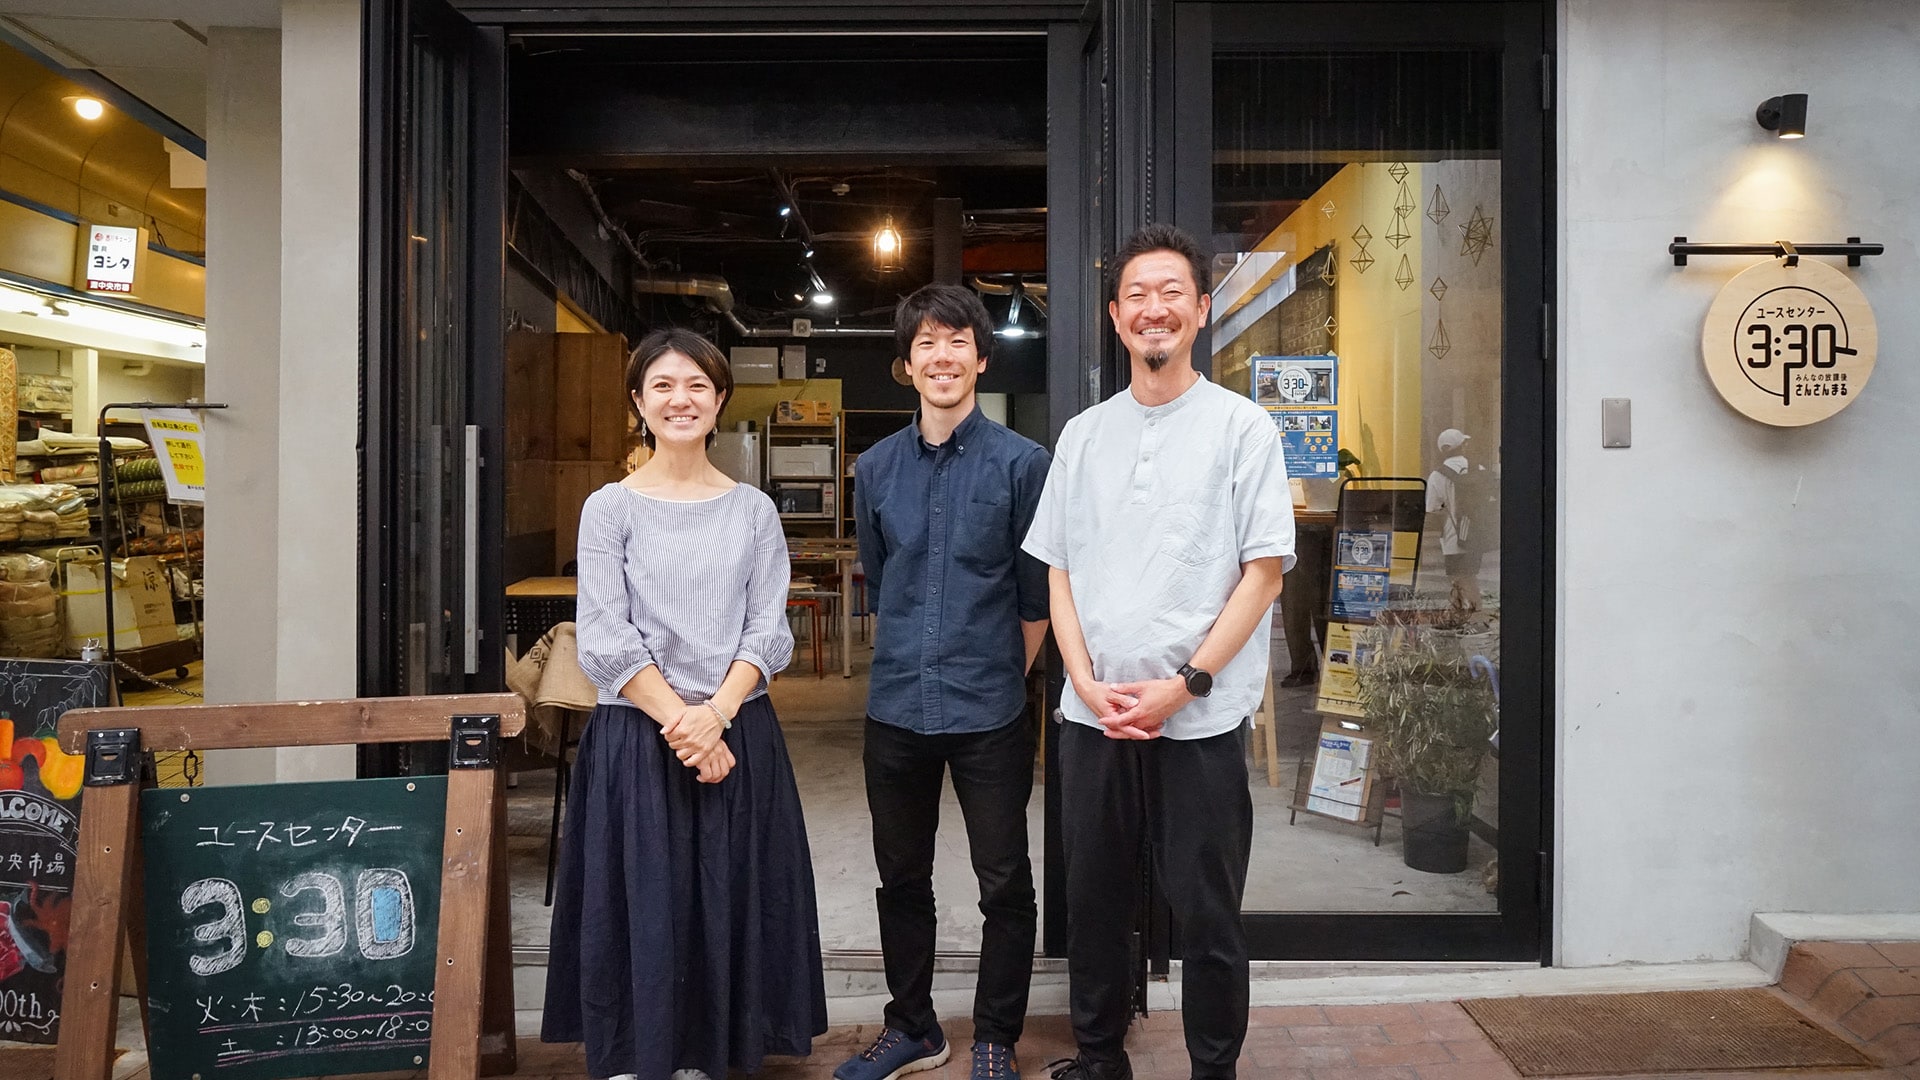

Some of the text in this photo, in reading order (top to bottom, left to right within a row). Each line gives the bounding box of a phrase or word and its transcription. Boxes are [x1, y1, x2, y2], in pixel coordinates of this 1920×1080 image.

[93, 255, 130, 270] ヨシタ
[1756, 306, 1826, 319] ユースセンター
[1747, 323, 1837, 369] 3:30
[1795, 373, 1848, 382] みんなの放課後
[1795, 383, 1848, 397] さんさんまる
[196, 816, 403, 851] ユースセンター
[181, 868, 416, 976] 3:30
[0, 989, 43, 1019] 0th
